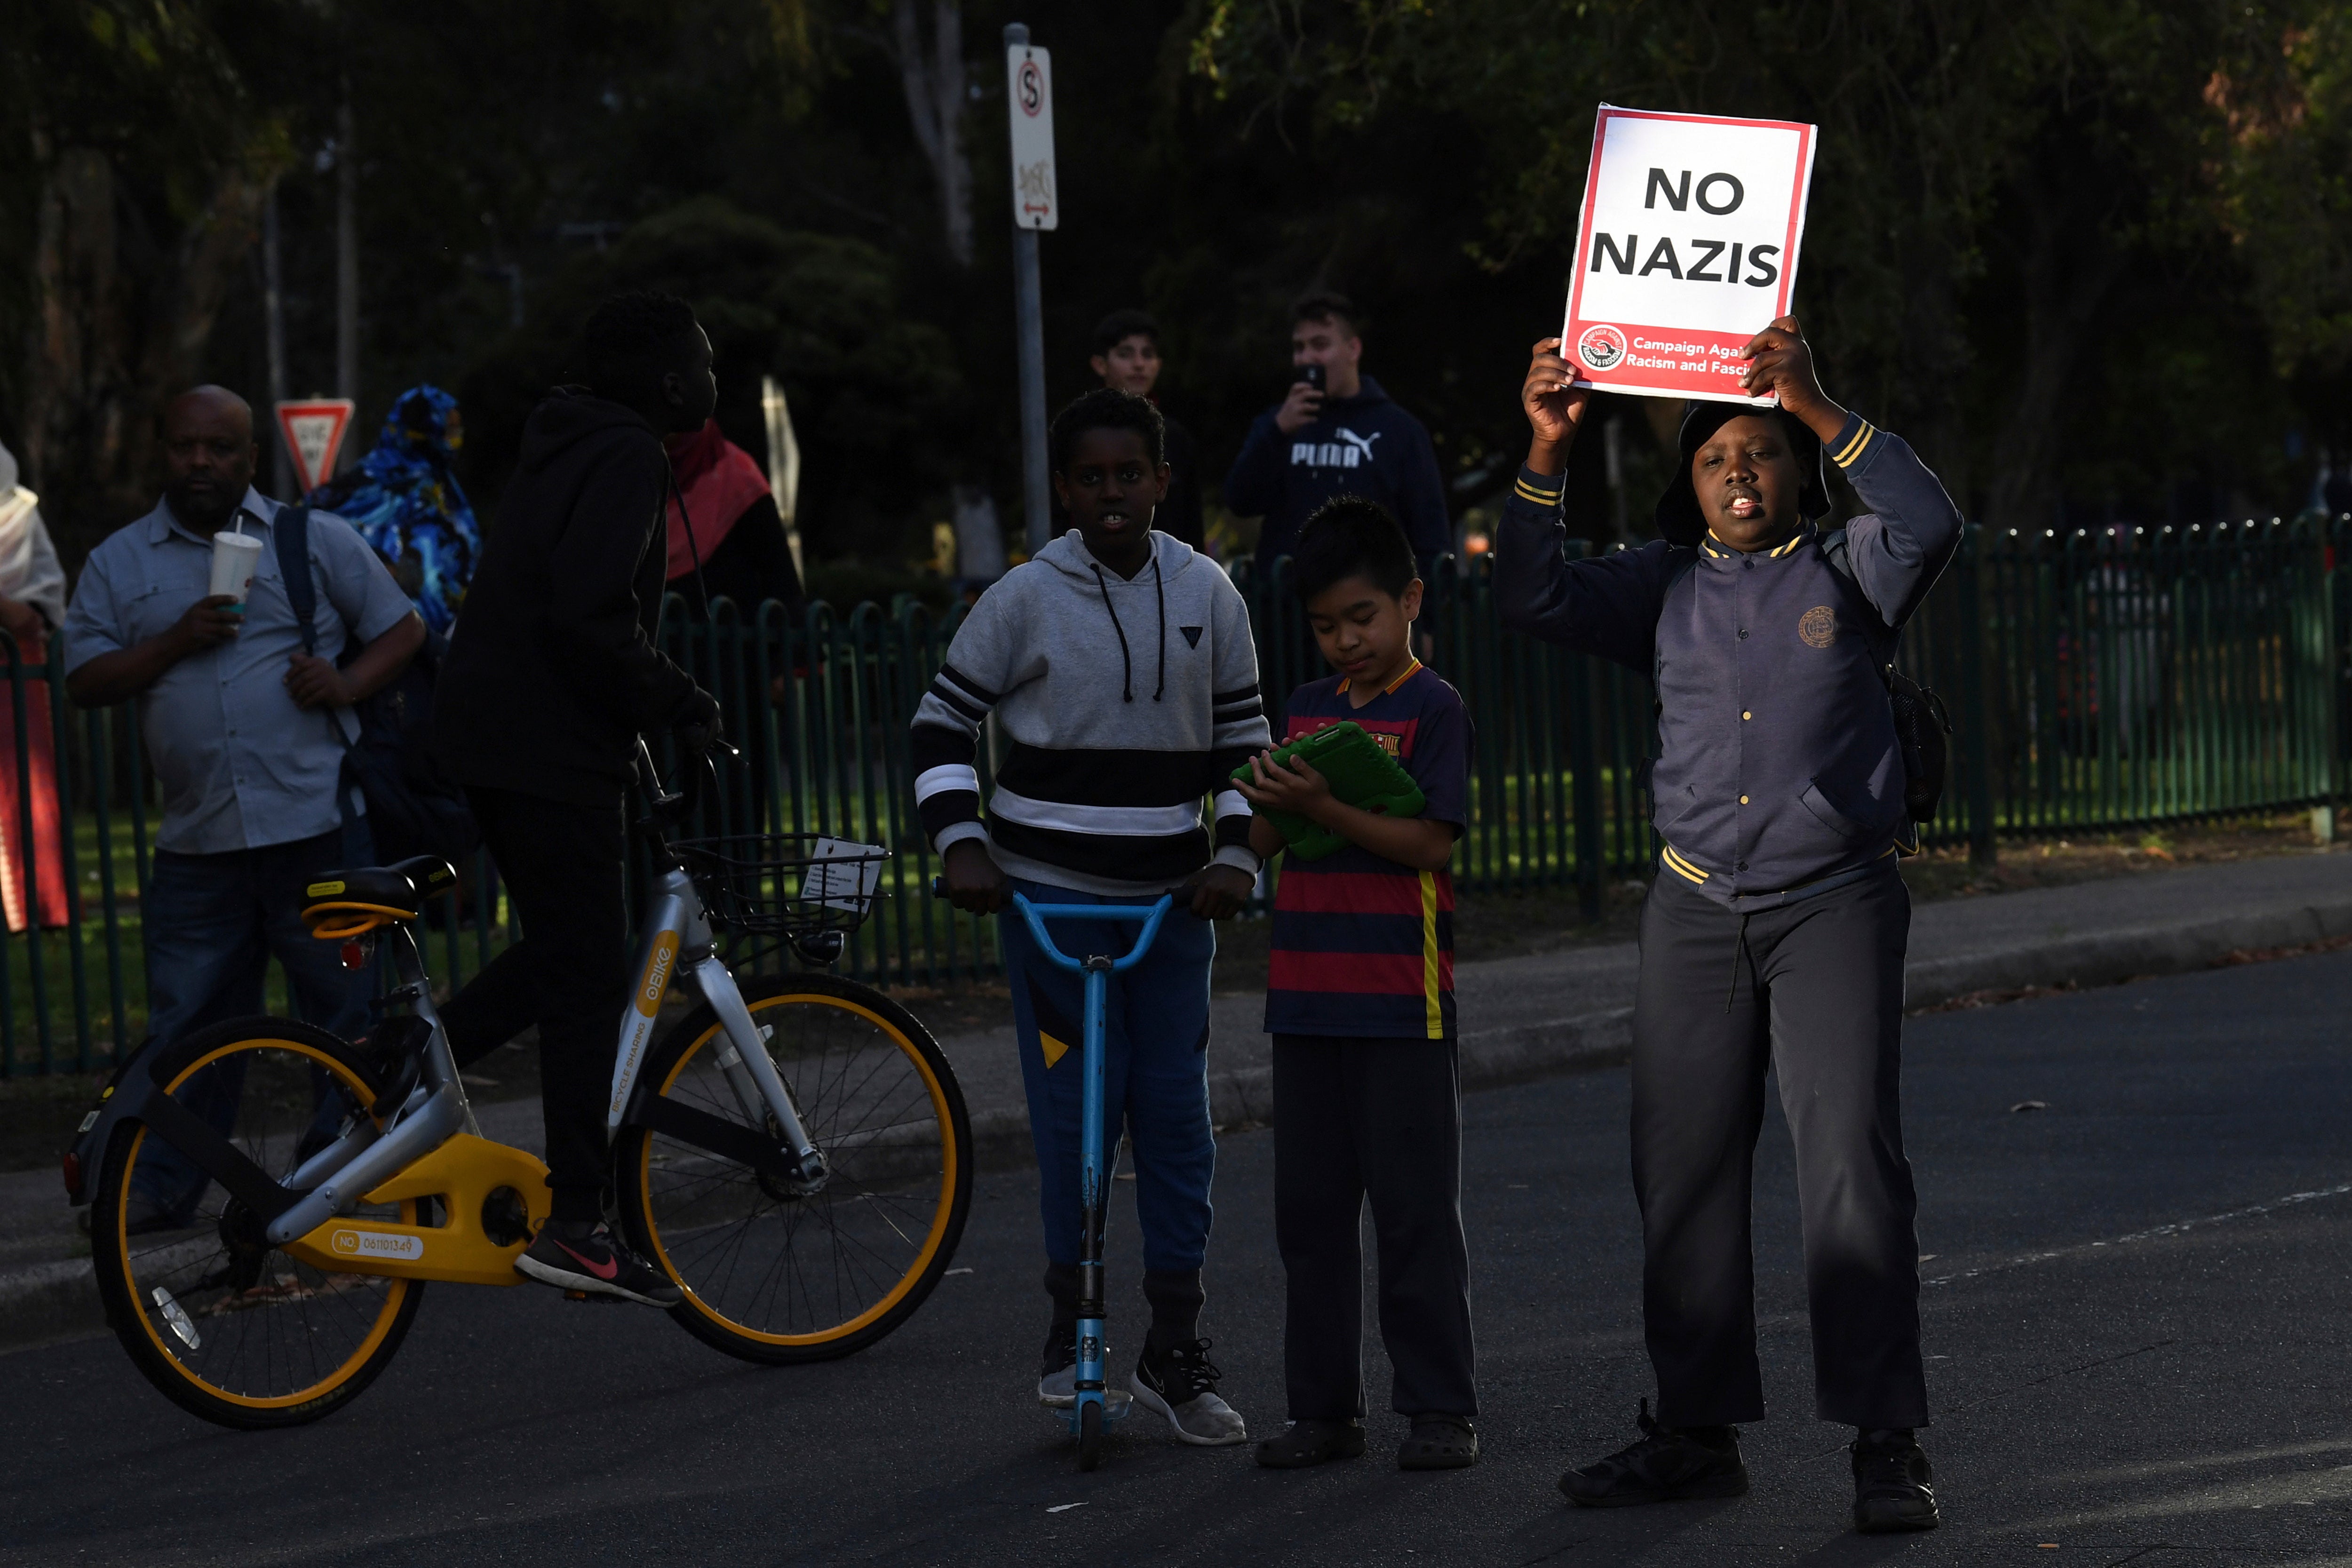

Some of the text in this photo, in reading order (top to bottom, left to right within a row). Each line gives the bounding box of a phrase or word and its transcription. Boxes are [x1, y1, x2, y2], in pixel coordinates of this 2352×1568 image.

[1645, 167, 1744, 215] NO
[1590, 232, 1780, 287] NAZIS
[1583, 329, 1622, 348] CAMPAIGN AGAINST
[1633, 336, 1705, 356] Campaign
[1583, 347, 1597, 365] RACISM
[1602, 350, 1621, 366] FASCISM
[1627, 354, 1676, 370] Racism
[1680, 359, 1707, 372] and
[1290, 442, 1361, 468] PUMA
[612, 1022, 646, 1113] BICYCLE SHARING
[340, 1236, 356, 1247] NO.
